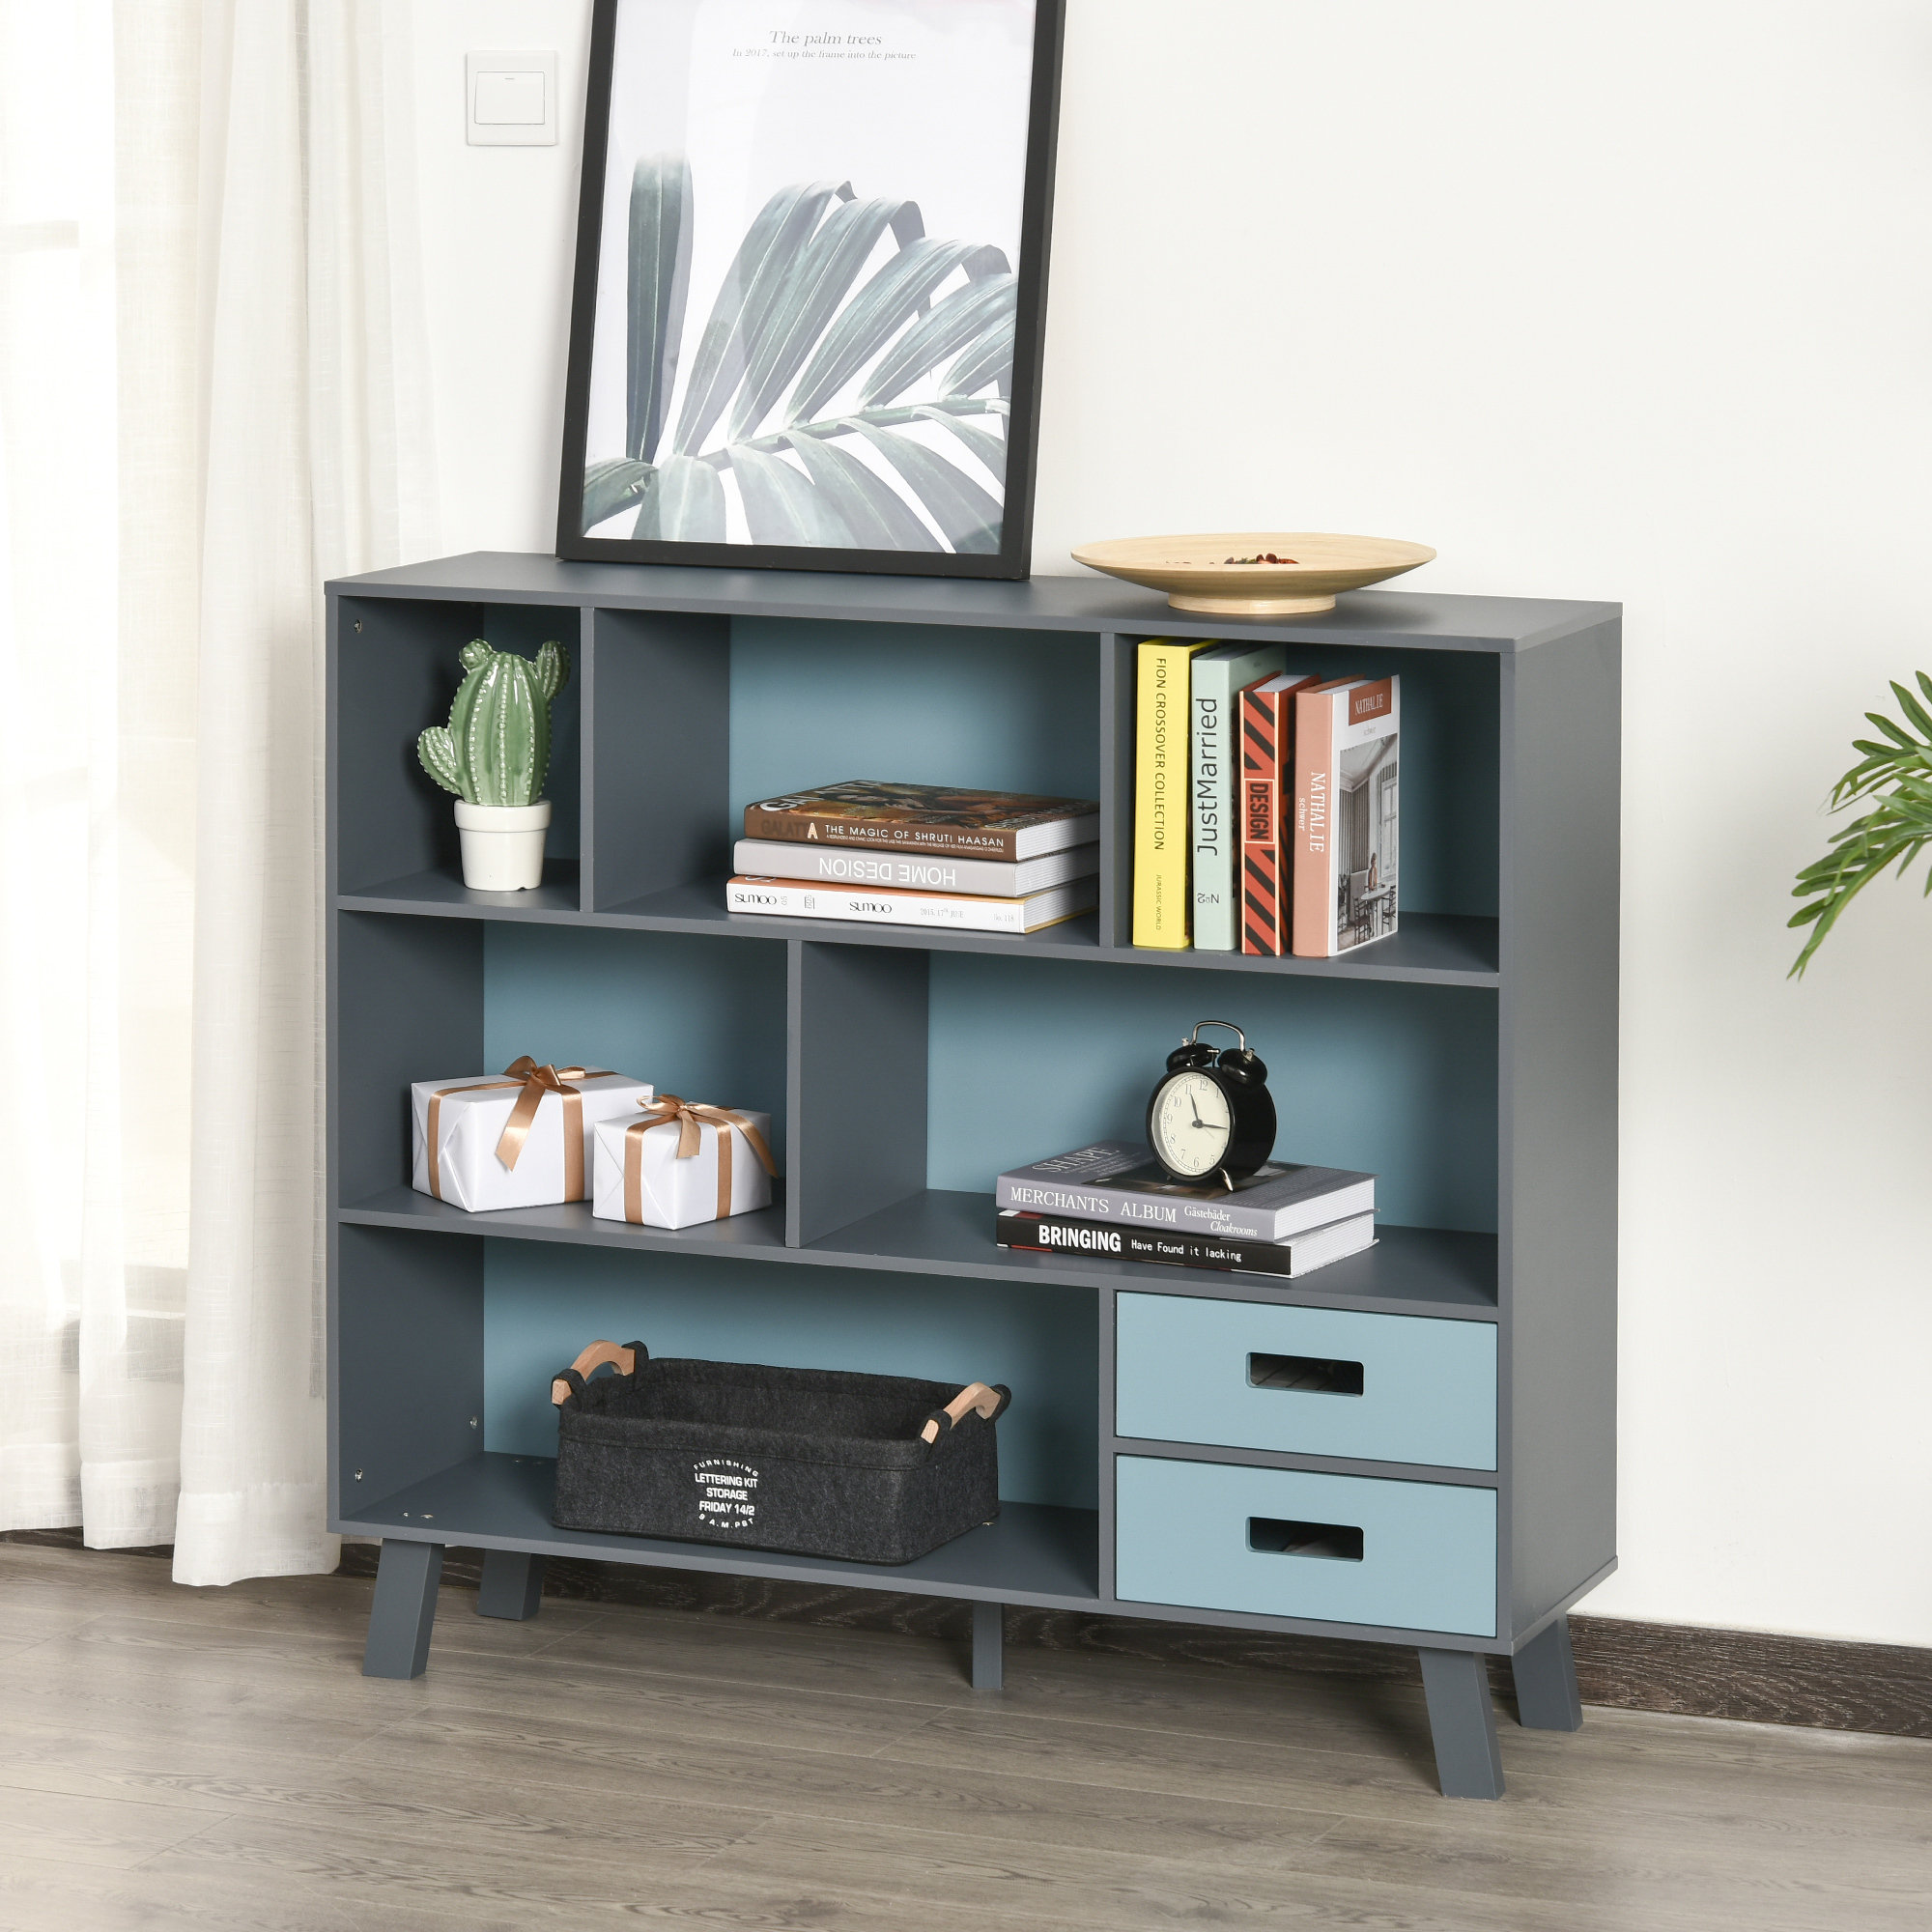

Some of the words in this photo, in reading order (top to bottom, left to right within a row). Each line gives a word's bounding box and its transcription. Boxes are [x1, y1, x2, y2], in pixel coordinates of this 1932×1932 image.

[768, 30, 800, 43] The
[804, 31, 842, 46] palm
[846, 34, 882, 44] trees
[732, 48, 743, 57] In
[787, 50, 800, 59] up
[802, 49, 816, 58] the
[819, 49, 845, 58] frame
[847, 49, 866, 59] into
[867, 50, 882, 59] the
[884, 50, 917, 60] picture
[1155, 658, 1167, 689] FION
[1354, 693, 1383, 716] NATHALIE
[1154, 693, 1167, 769] CROSSOVER
[1153, 772, 1166, 850] COLLECTION
[1249, 782, 1269, 840] DESIGN
[1309, 771, 1326, 853] NATHALIE
[825, 824, 844, 835] THE
[849, 826, 889, 838] MAGIC
[894, 830, 910, 839] OF
[915, 831, 952, 843] SHRUTI
[957, 835, 1004, 848] HAASAN
[897, 864, 956, 887] HOME
[1199, 1079, 1208, 1092] 12
[1174, 1096, 1182, 1108] 10
[1166, 1113, 1174, 1124] 9
[1180, 1149, 1186, 1160] 7
[1193, 1156, 1200, 1168] 6
[1010, 1186, 1110, 1213] MERCHANTS
[1120, 1201, 1178, 1223] ALBUM
[1183, 1205, 1231, 1222] Gästebäder
[1209, 1220, 1259, 1236] Cloakrooms
[1038, 1224, 1122, 1253] BRINGING
[1131, 1238, 1153, 1251] Have
[1157, 1241, 1184, 1255] Found
[1190, 1245, 1200, 1257] it
[1206, 1246, 1242, 1263] lacking
[693, 1459, 759, 1477] FURNISHING
[695, 1472, 743, 1487] LETTERING
[744, 1477, 758, 1489] KIT
[706, 1488, 749, 1501] STORAGE
[698, 1500, 732, 1514] FRIDAY
[734, 1503, 755, 1517] 14/2
